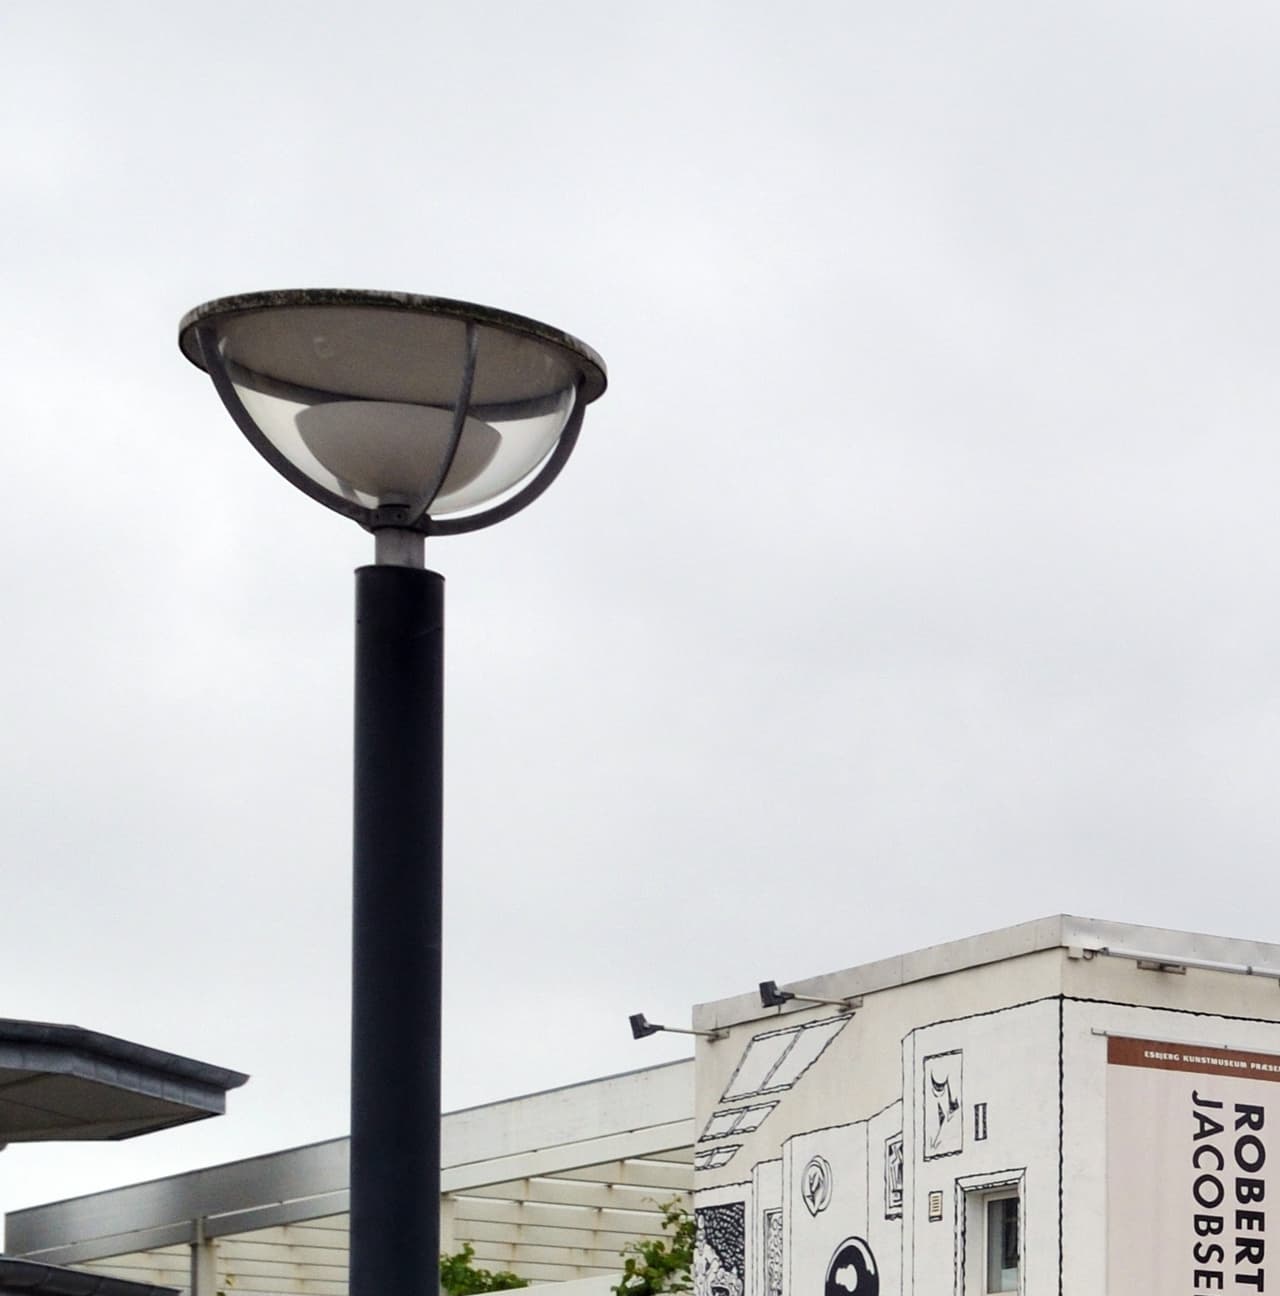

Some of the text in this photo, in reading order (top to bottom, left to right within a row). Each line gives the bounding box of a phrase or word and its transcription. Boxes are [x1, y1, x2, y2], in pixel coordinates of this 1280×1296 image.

[1144, 1050, 1180, 1062] ESBJERG
[1183, 1055, 1248, 1069] KUNSTMUSEUM
[1234, 1103, 1266, 1293] ROBERT
